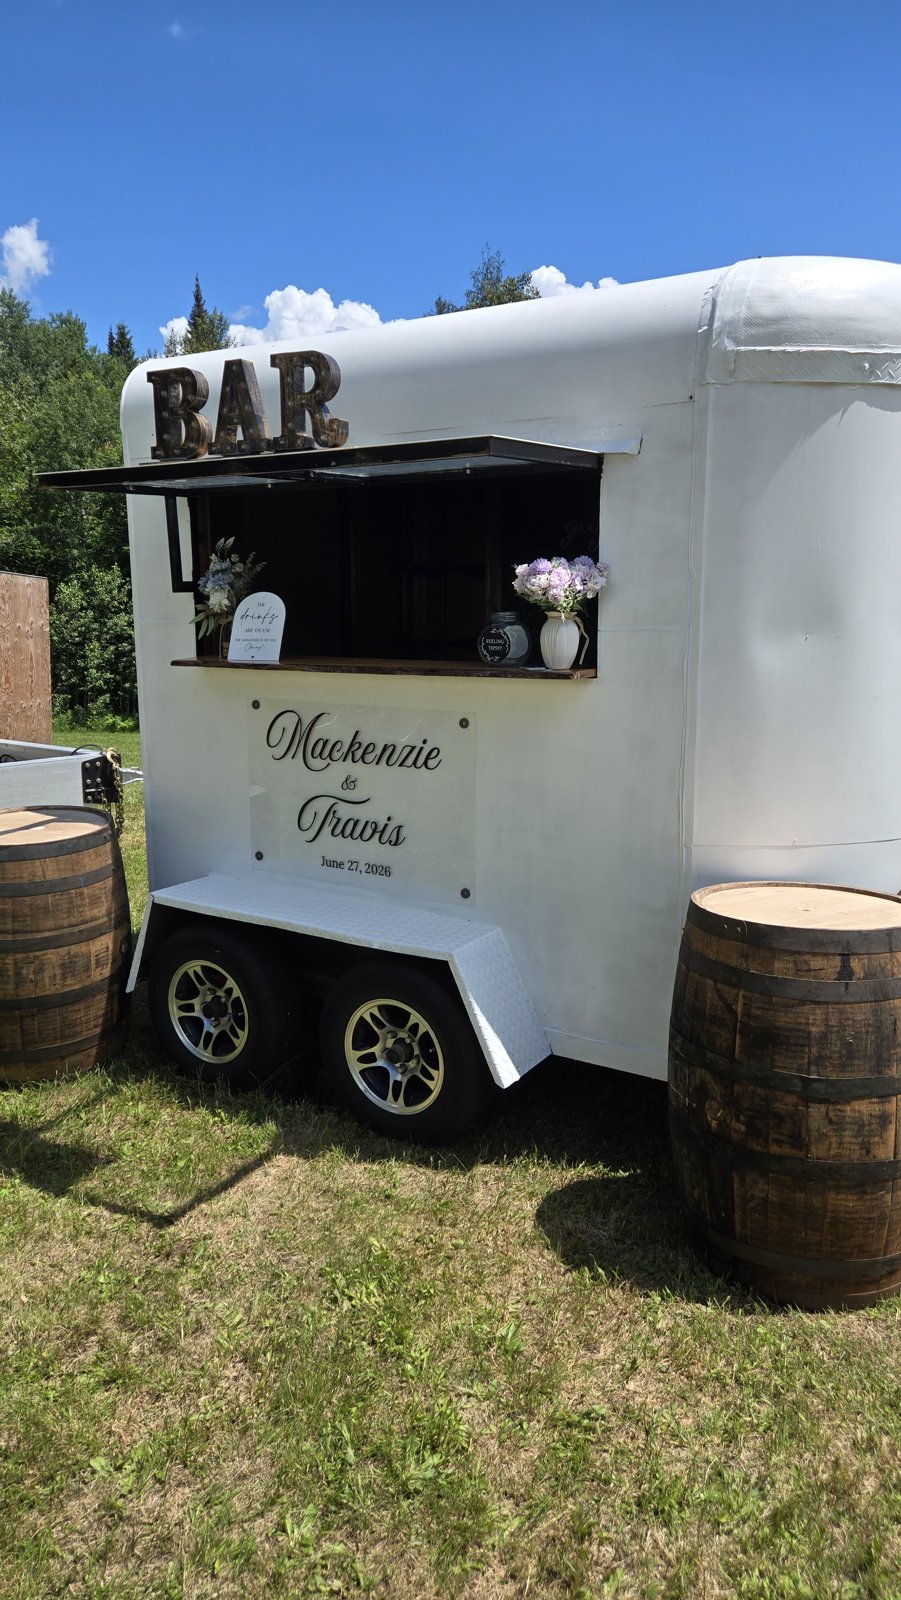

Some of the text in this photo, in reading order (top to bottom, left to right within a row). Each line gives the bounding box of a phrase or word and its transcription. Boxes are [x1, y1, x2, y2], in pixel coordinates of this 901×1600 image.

[146, 350, 349, 460] BAR
[240, 606, 279, 626] drinks
[266, 709, 442, 772] Mackenzie
[341, 774, 357, 791] &
[297, 794, 406, 847] Travis
[320, 856, 392, 878] June 27, 2026
